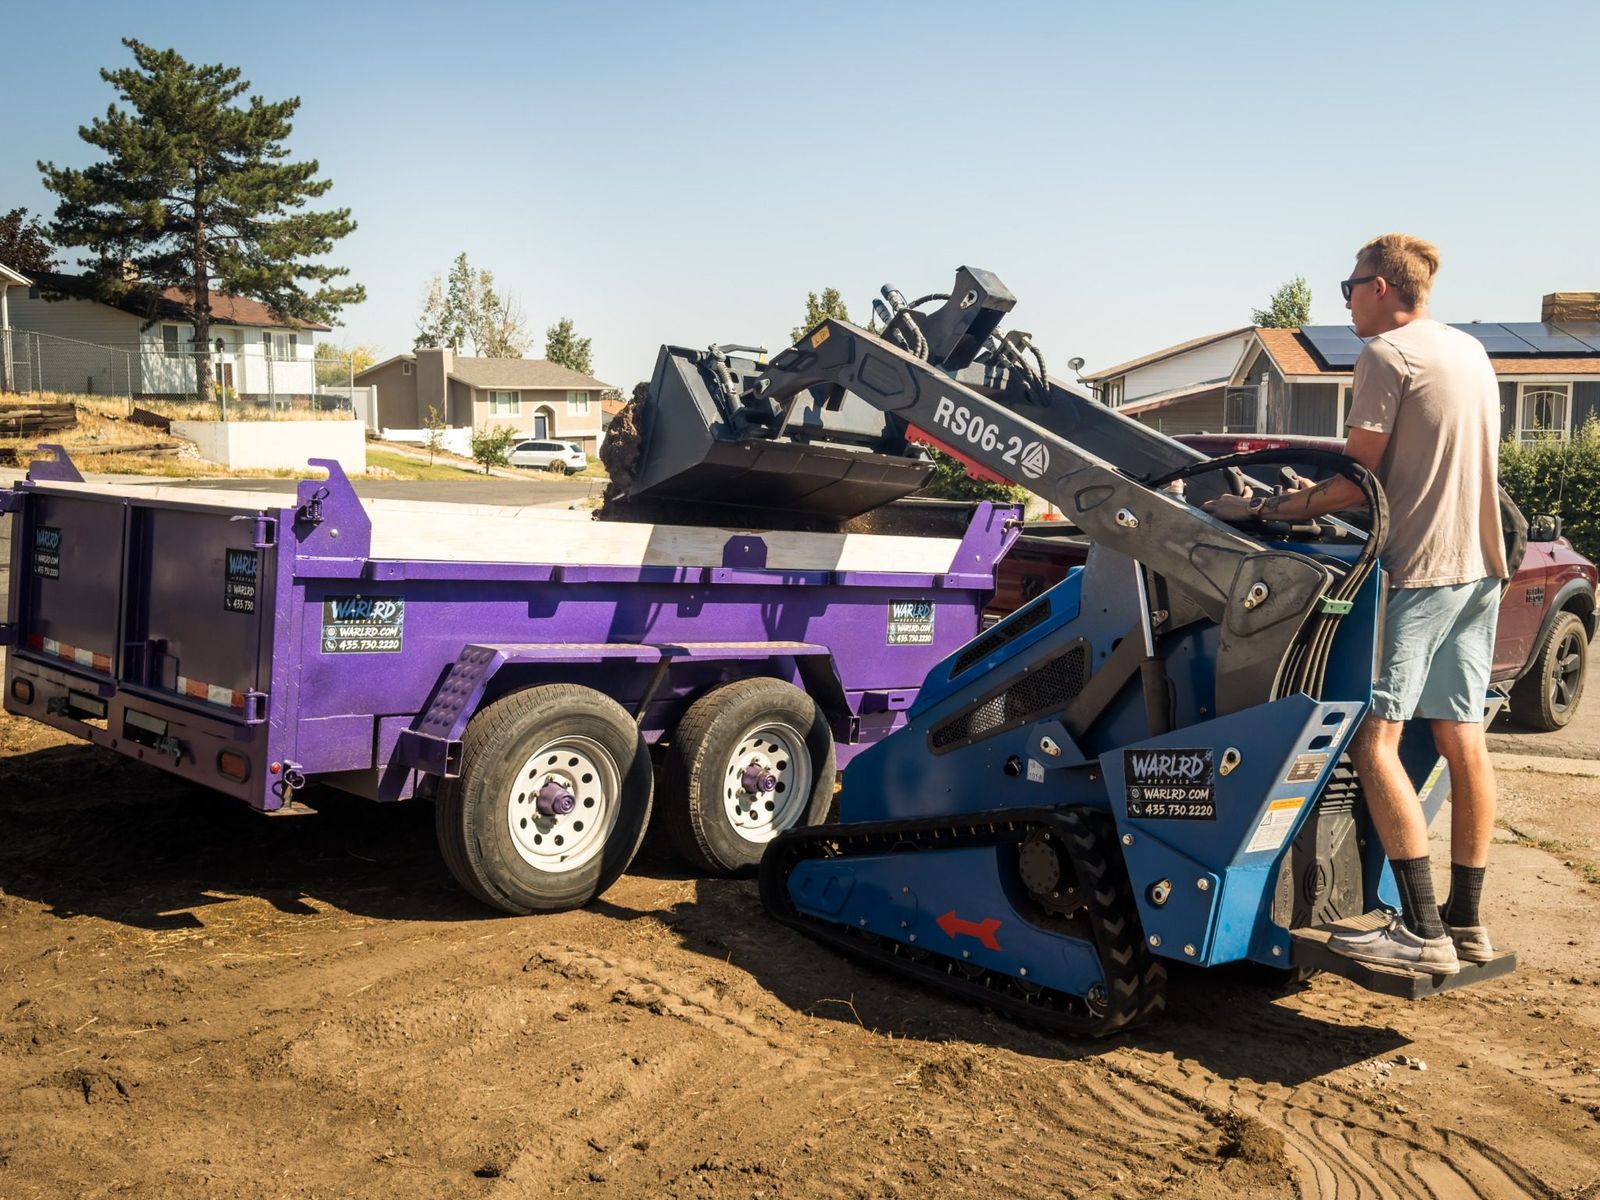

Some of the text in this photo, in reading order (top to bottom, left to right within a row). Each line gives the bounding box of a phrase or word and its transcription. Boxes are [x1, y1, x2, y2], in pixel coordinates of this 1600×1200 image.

[933, 395, 1023, 466] RS06-2
[36, 529, 59, 549] WARLRD
[331, 598, 397, 621] WARLRD
[893, 602, 930, 619] WARLRD
[339, 626, 397, 637] WARLRD.COM
[338, 640, 399, 651] 435.730.2220
[1132, 752, 1204, 778] WARLRD
[1143, 788, 1210, 801] WARLRD.COM
[1145, 804, 1213, 816] 435.730.2220
